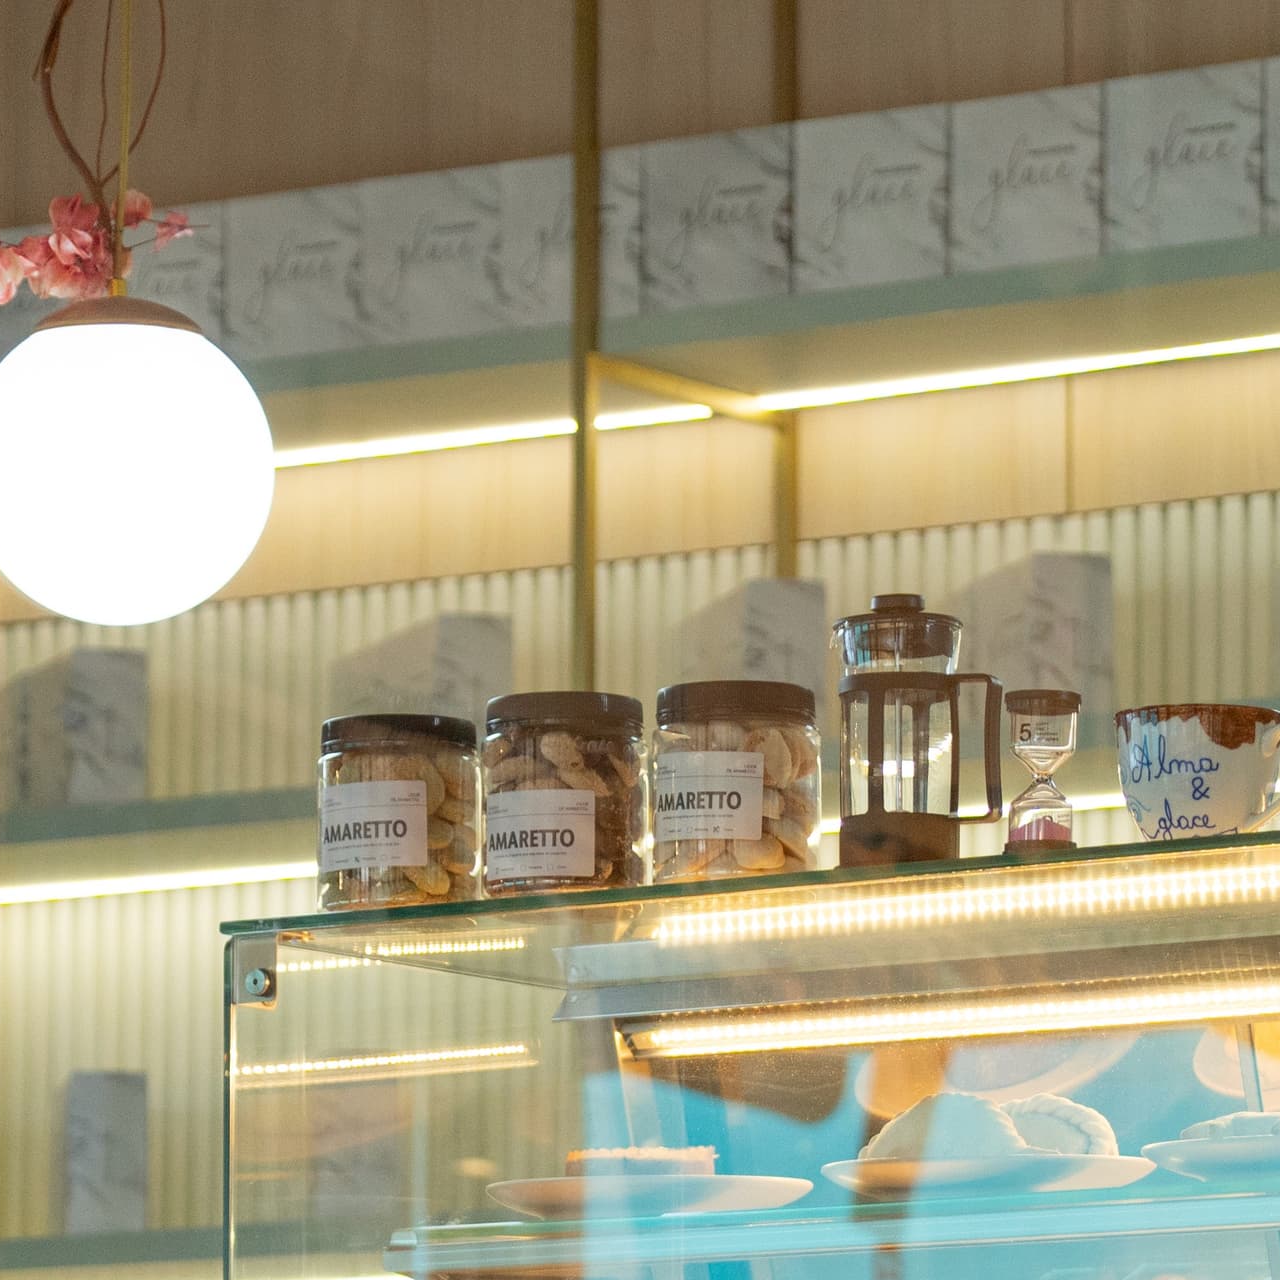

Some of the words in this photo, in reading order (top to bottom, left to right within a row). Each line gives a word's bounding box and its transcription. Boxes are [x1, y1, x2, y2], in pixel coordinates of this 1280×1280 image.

[1019, 723, 1032, 742] 5
[1132, 734, 1219, 783] Alma
[1191, 776, 1210, 800] &
[656, 791, 742, 813] AMARETTO
[1158, 798, 1216, 840] glace
[323, 819, 408, 845] AMARETTO
[488, 828, 575, 852] AMARETTO
